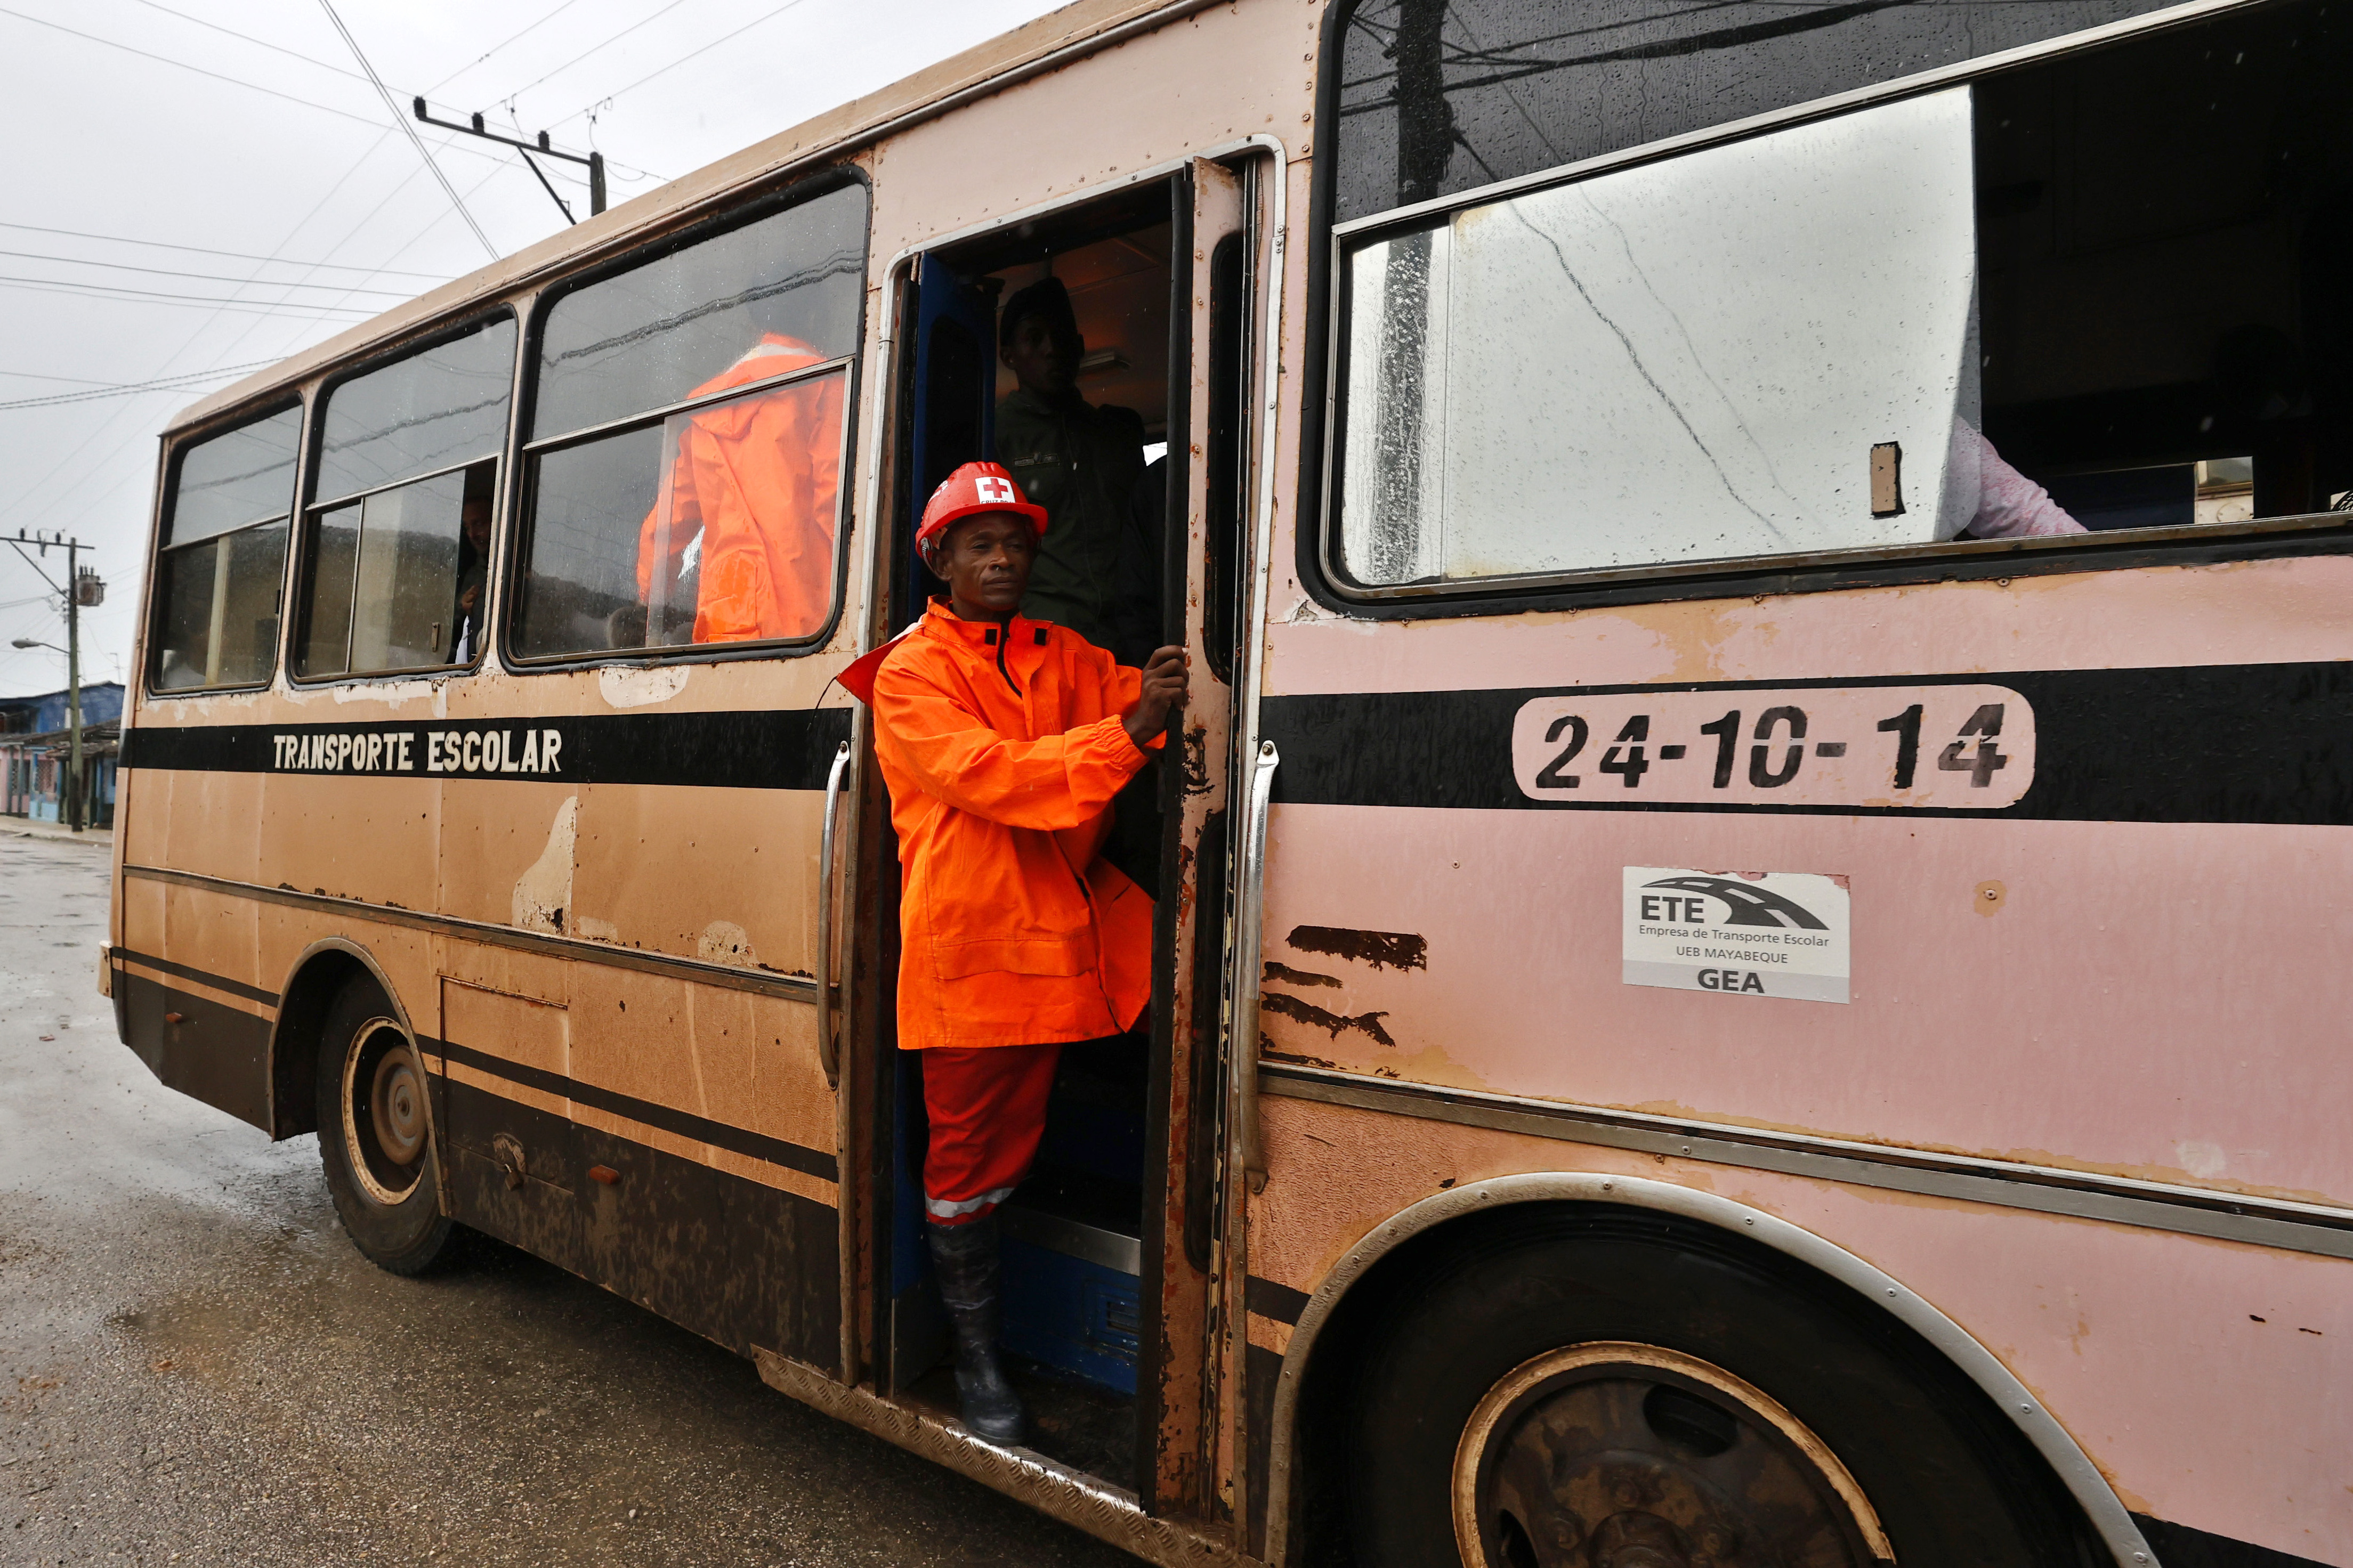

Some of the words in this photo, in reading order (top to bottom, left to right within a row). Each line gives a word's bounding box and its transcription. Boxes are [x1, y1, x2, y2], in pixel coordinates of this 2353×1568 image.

[273, 732, 414, 770] TRANSPORTE
[427, 729, 562, 773] ESCOLAR
[1641, 895, 1705, 924] ETE
[1639, 925, 1689, 938] Empresa
[1693, 929, 1708, 938] de
[1711, 930, 1780, 944] Transporte
[1784, 934, 1830, 947] Escolar
[1677, 946, 1700, 957] UEB
[1705, 948, 1789, 963] MAYABEQUE
[1697, 969, 1765, 994] GEA
